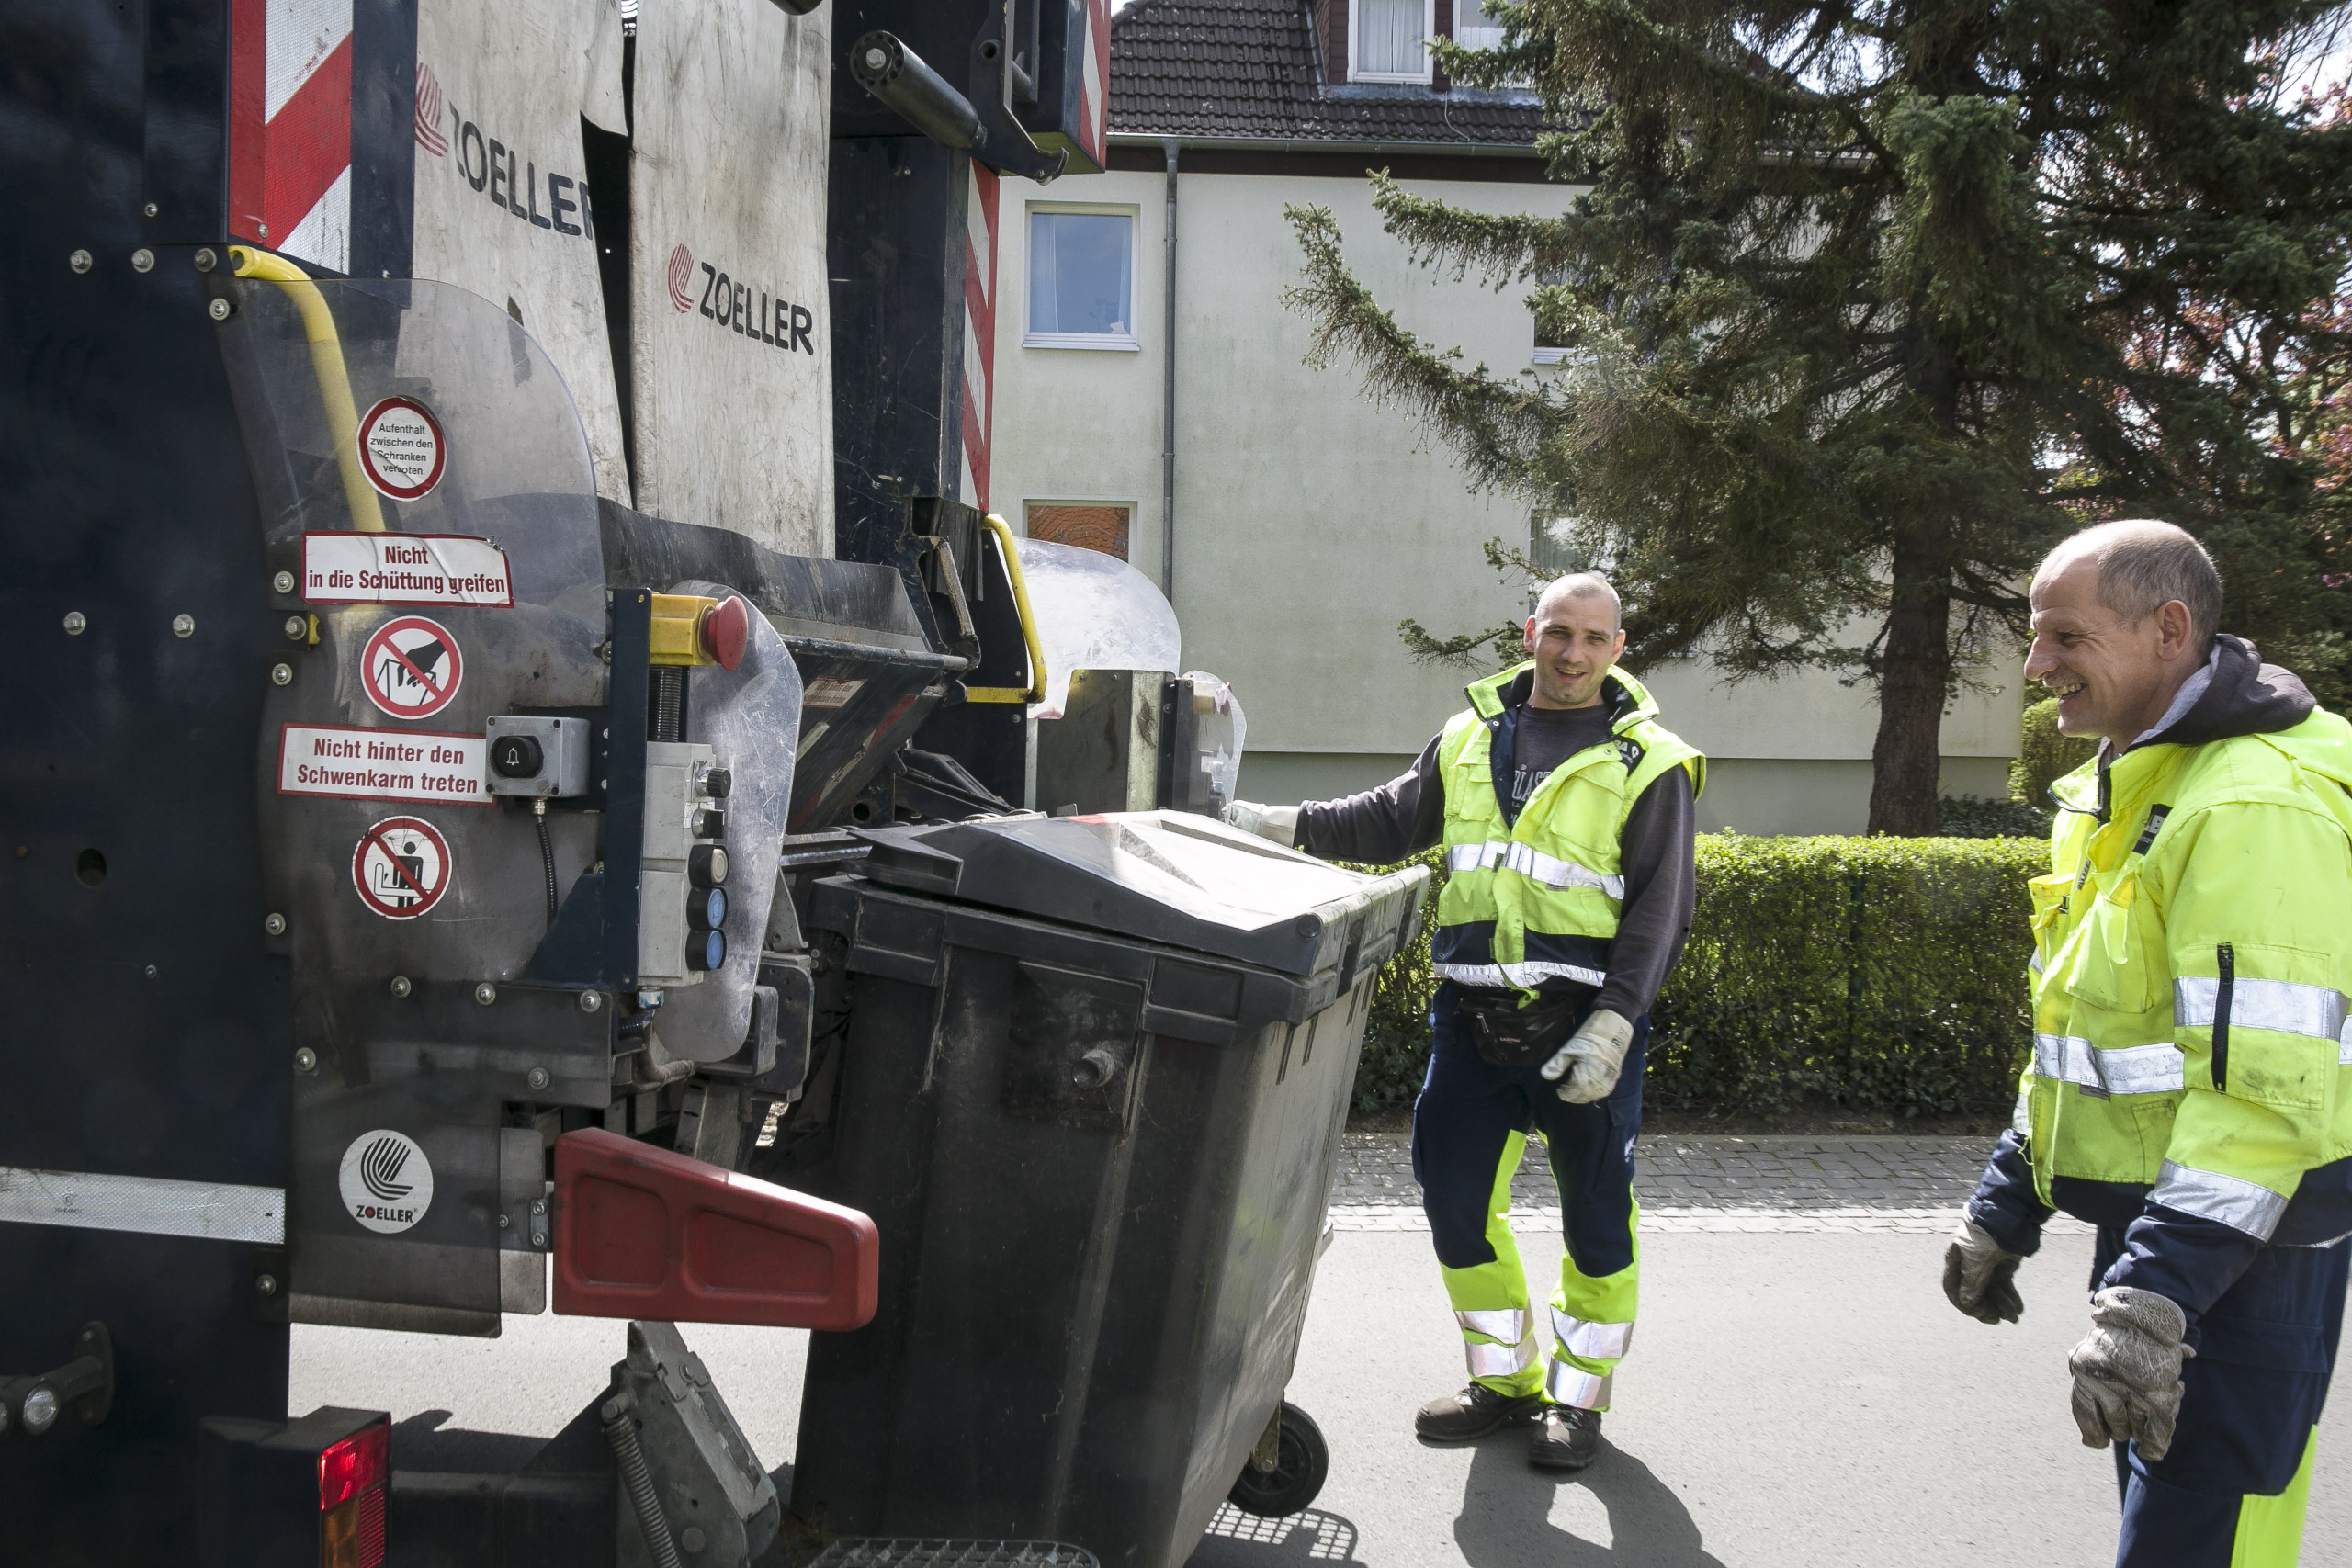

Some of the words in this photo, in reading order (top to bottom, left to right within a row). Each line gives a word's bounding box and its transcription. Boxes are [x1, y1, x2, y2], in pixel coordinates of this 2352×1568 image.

[448, 100, 593, 240] ZOELLE
[699, 261, 814, 355] ZOELLER
[379, 423, 425, 434] Aufenthalt
[370, 437, 413, 447] zwischen
[415, 439, 433, 448] den
[377, 450, 427, 462] Schranken
[385, 546, 429, 564] Nicht
[309, 570, 323, 588] in
[328, 570, 354, 588] die
[359, 570, 444, 594] Schüttung
[448, 573, 505, 595] greifen
[314, 738, 361, 759] Nicht
[368, 741, 424, 762] hinter
[430, 745, 464, 764] den
[297, 764, 414, 790] Schwenkarm
[421, 773, 478, 794] treten
